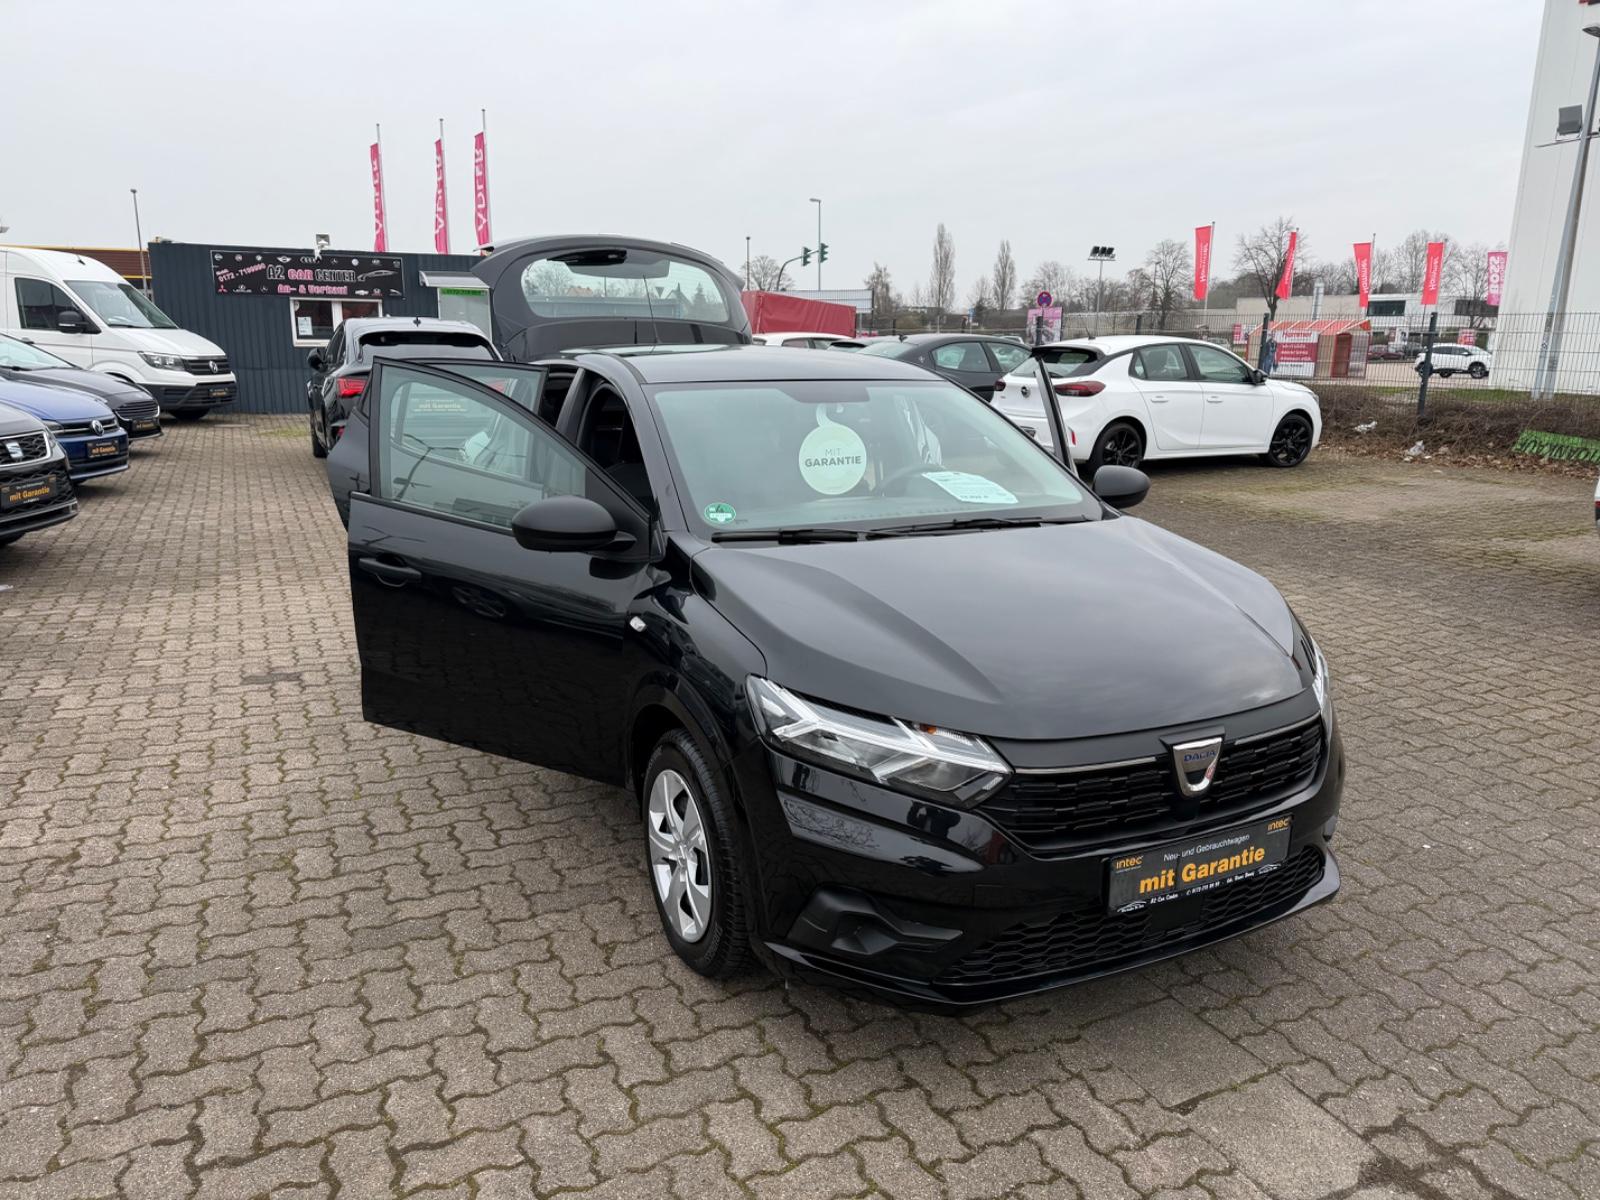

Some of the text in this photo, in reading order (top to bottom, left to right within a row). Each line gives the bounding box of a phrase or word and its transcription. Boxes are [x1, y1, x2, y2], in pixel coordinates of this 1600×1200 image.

[267, 264, 356, 283] A2 CAR CENTER
[825, 447, 842, 457] MIT
[804, 455, 862, 468] GARANTIE
[10, 490, 22, 502] mit
[22, 486, 50, 499] Garantie
[1181, 847, 1195, 857] und
[1116, 856, 1143, 870] intec
[1139, 868, 1175, 894] mit
[1181, 846, 1265, 883] Garantie
